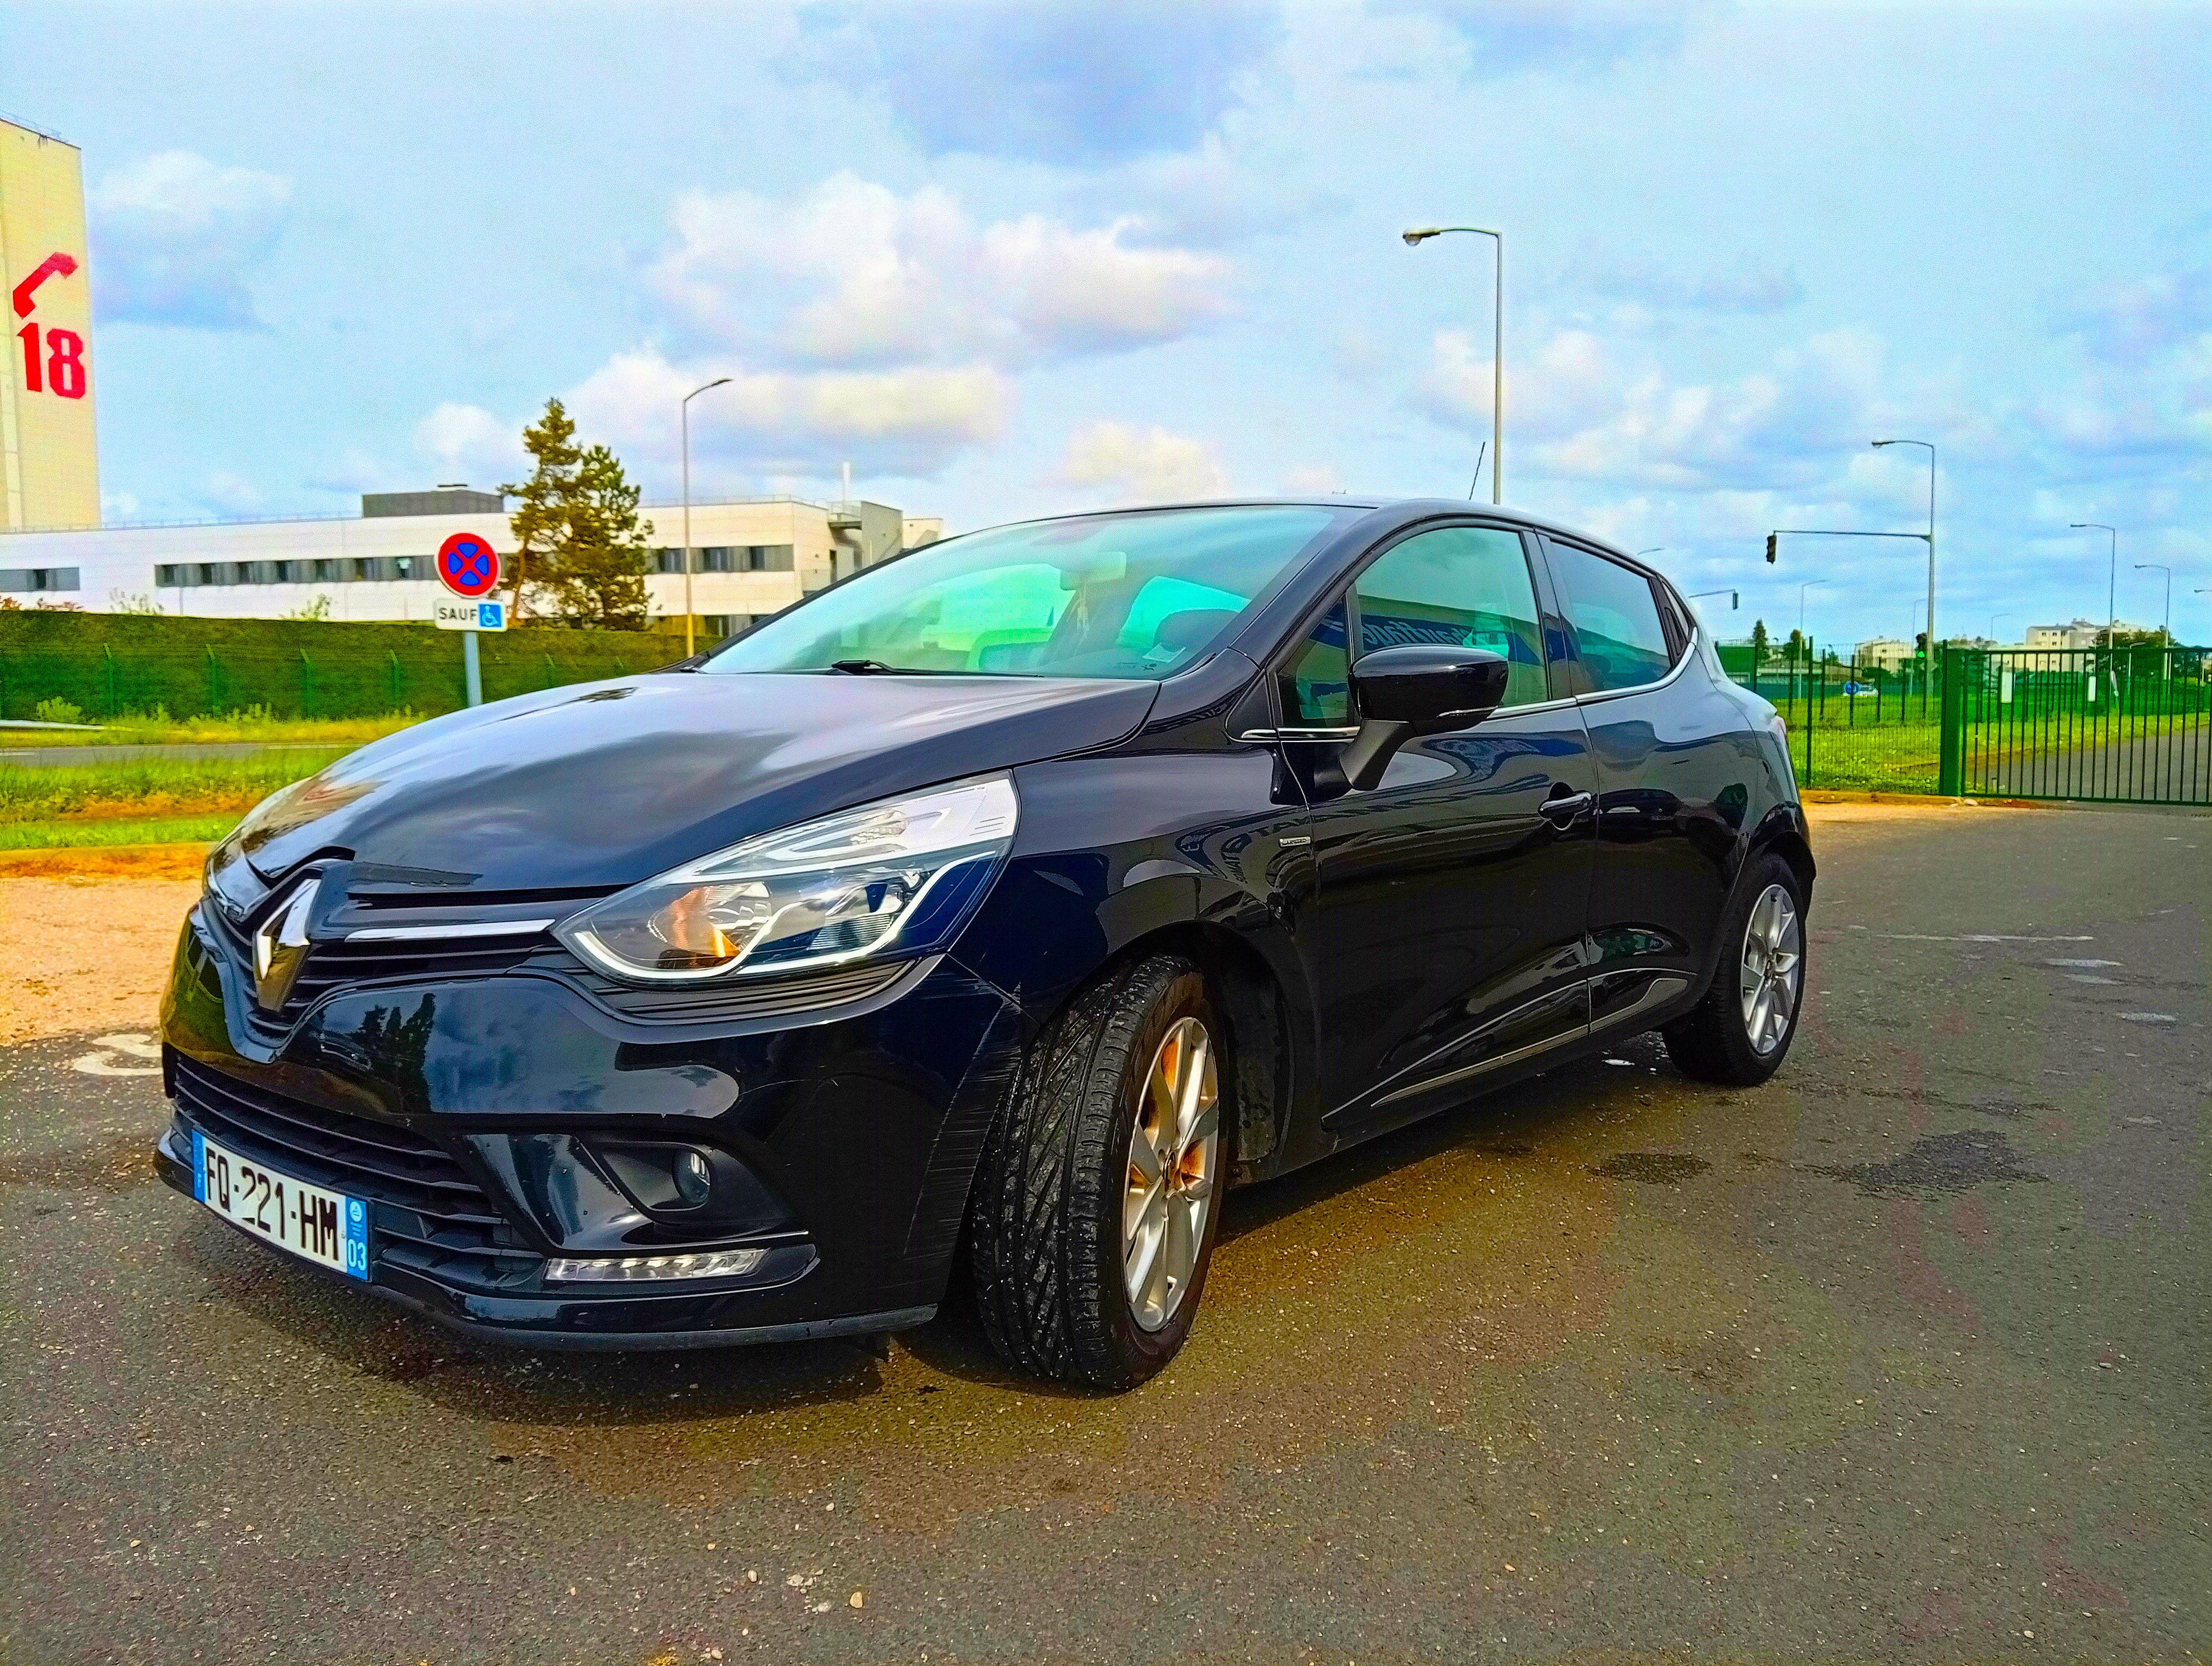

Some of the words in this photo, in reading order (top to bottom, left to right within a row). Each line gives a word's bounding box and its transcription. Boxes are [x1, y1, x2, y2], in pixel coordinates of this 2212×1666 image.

[17, 323, 86, 400] 18
[438, 607, 477, 620] SAUF
[348, 1238, 367, 1271] 03
